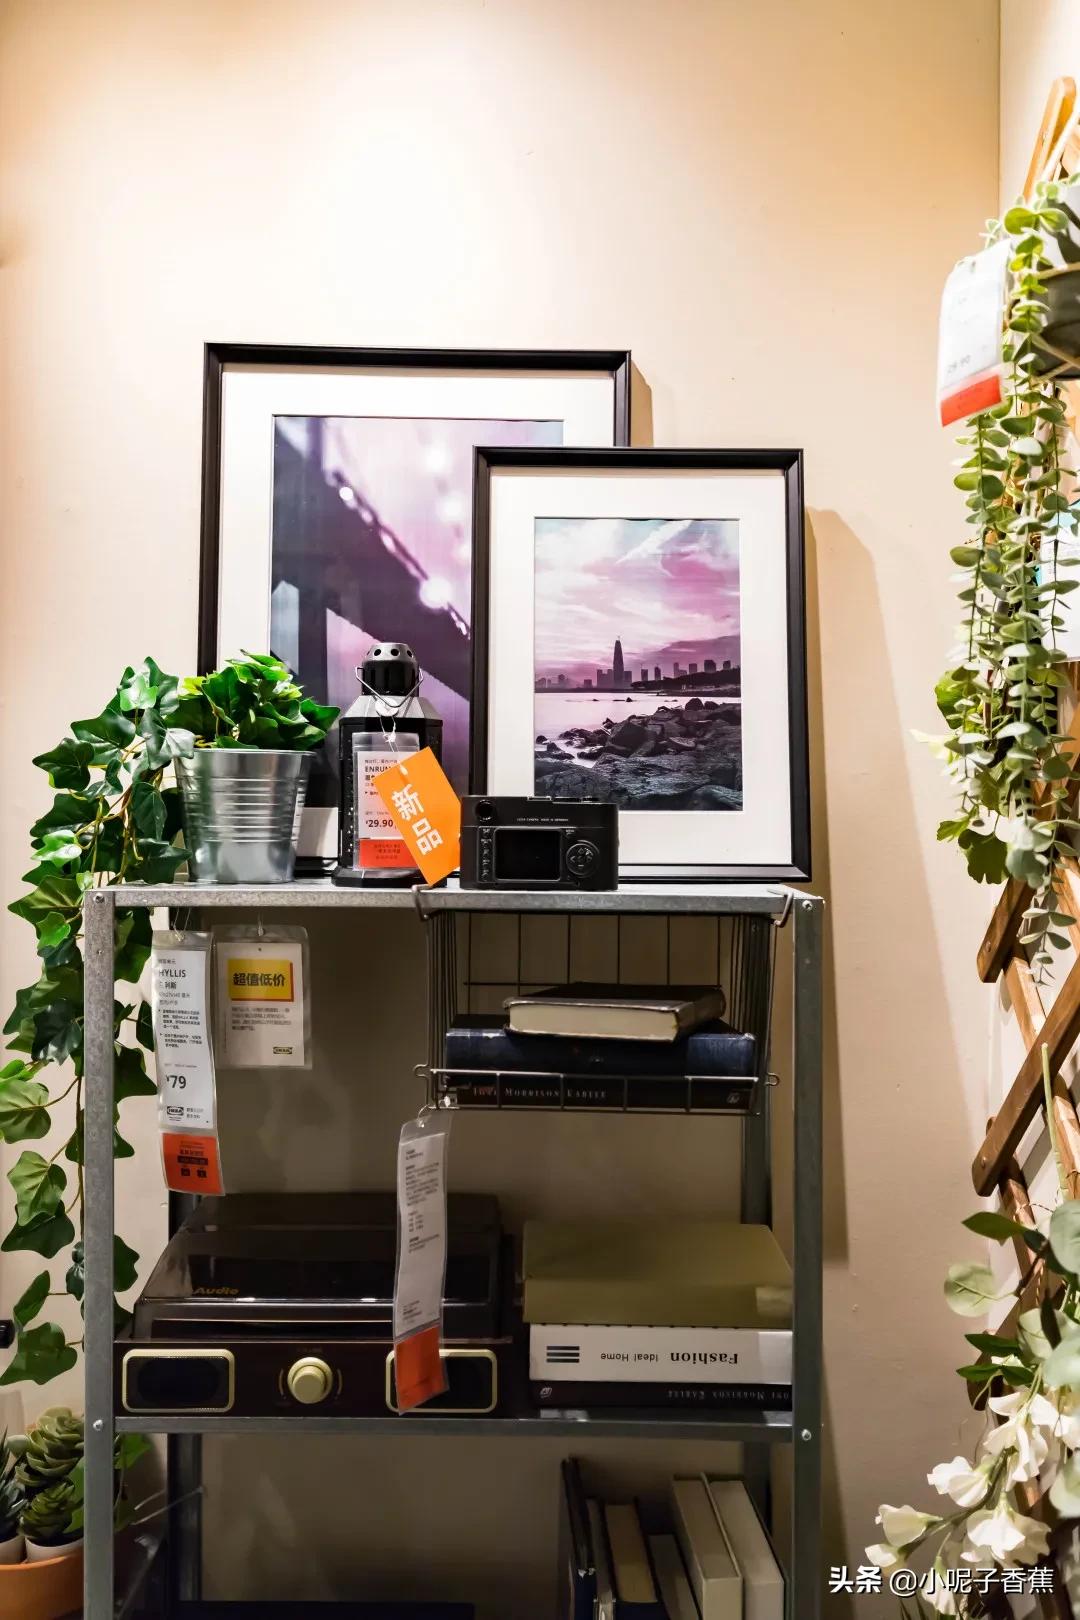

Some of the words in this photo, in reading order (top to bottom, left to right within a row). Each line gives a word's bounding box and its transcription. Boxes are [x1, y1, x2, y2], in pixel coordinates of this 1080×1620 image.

[391, 783, 444, 856] 新品
[159, 969, 187, 978] HYLLIS
[232, 972, 286, 987] 超值低价
[192, 1286, 239, 1295] Audio
[600, 1353, 629, 1362] Home
[634, 1353, 659, 1362] Ideal
[670, 1352, 738, 1364] Fashion
